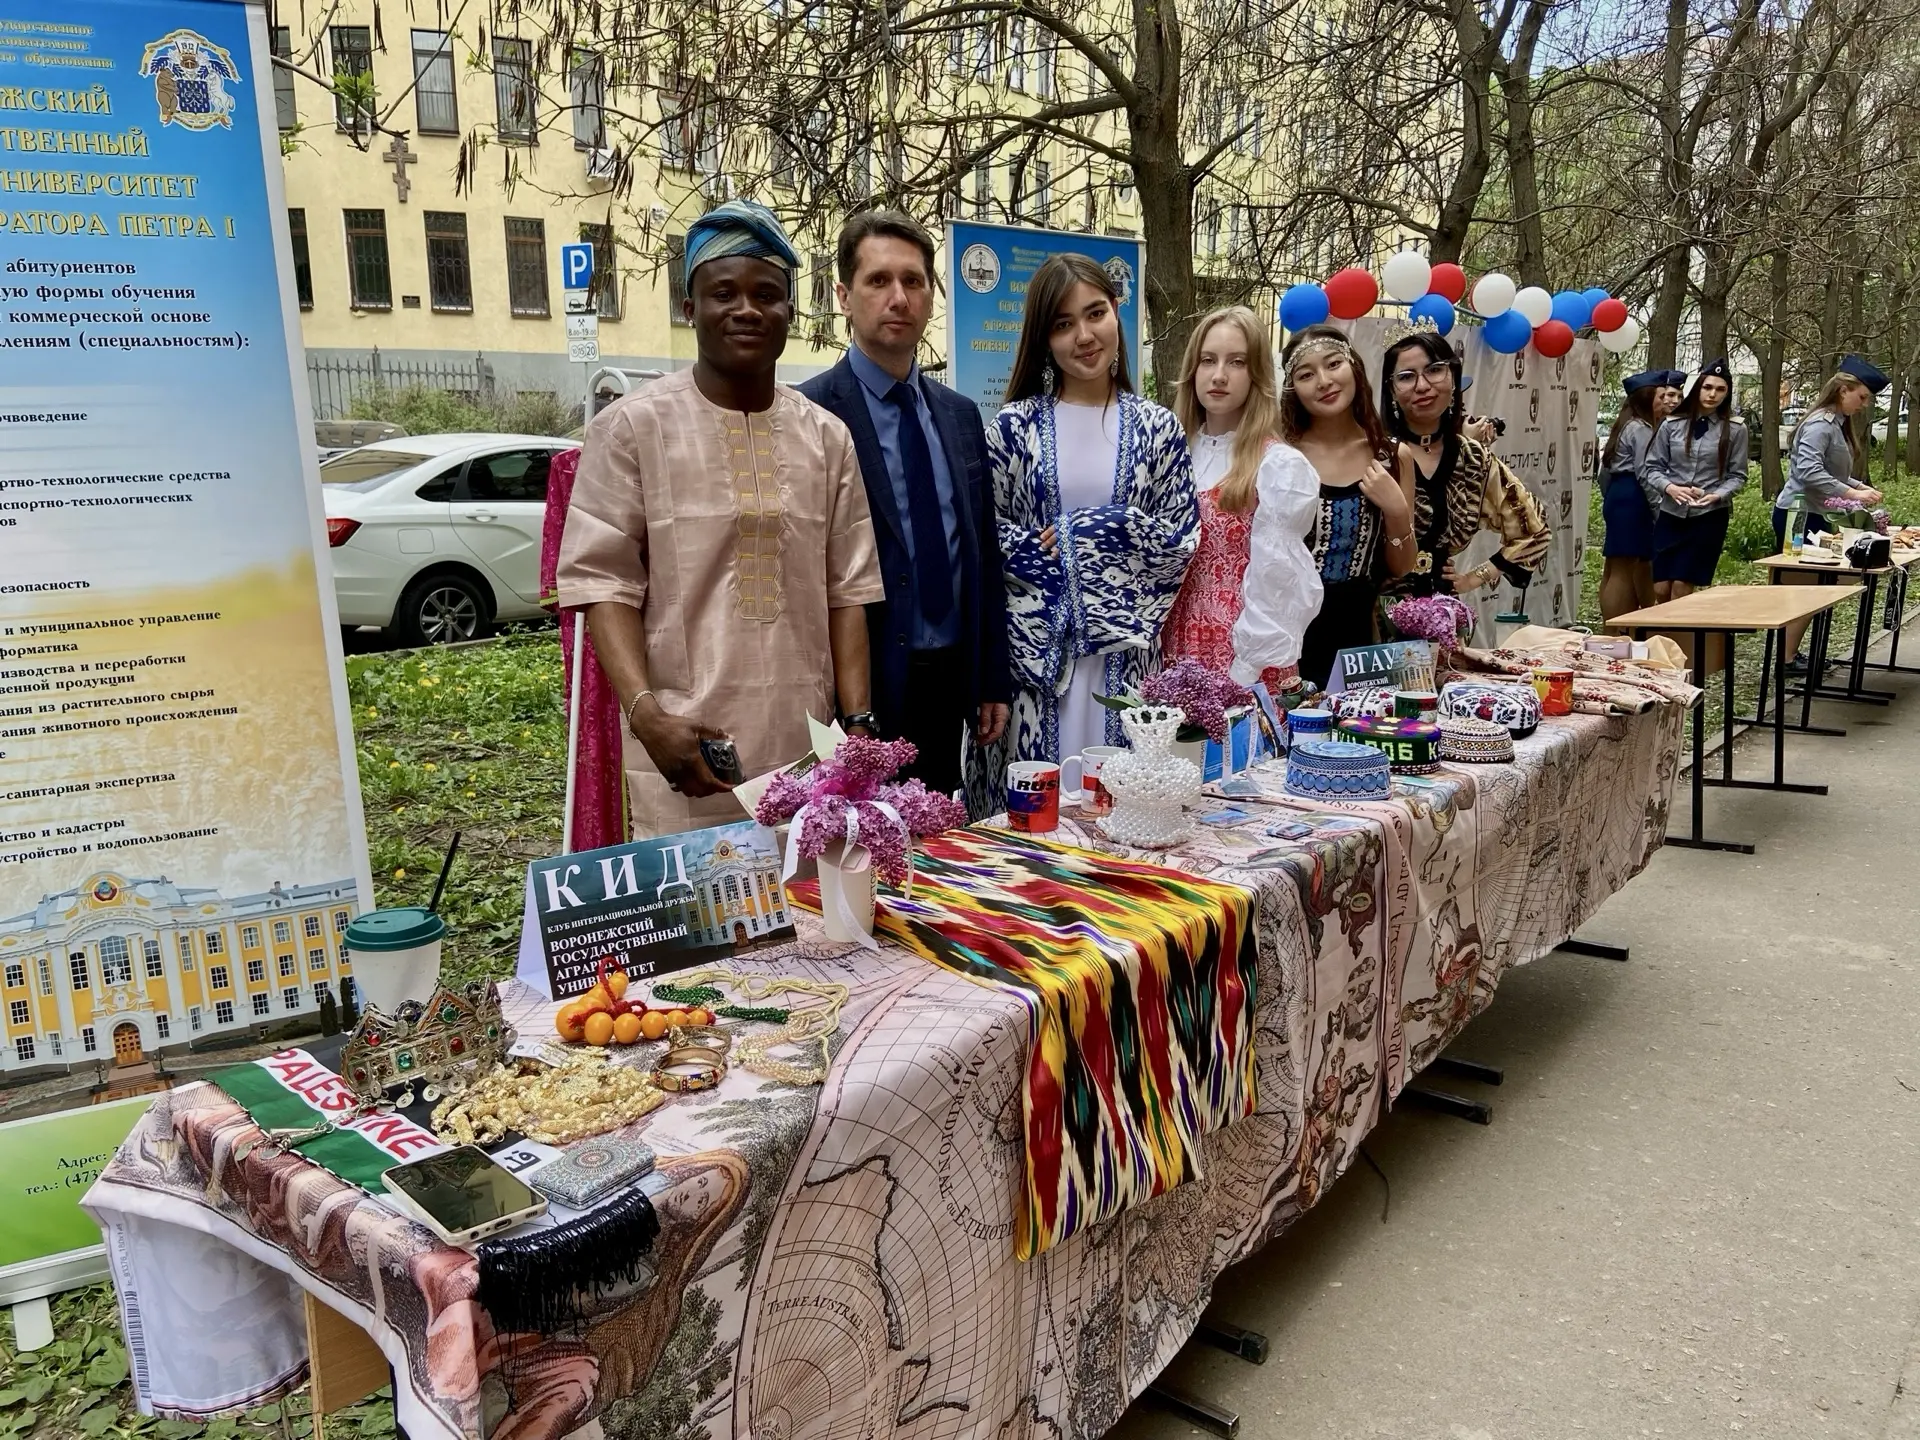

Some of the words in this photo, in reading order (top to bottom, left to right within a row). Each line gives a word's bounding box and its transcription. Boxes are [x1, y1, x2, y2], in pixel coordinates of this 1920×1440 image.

[119, 214, 216, 239] ПЕТРА
[6, 258, 136, 281] абитуриентов
[0, 288, 28, 303] ую
[36, 284, 104, 305] формы
[111, 284, 196, 304] обучения
[9, 309, 144, 329] коммерческой
[151, 312, 211, 325] основе
[79, 331, 250, 352] (специальностям):
[169, 469, 231, 484] средства
[5, 627, 14, 636] и
[20, 619, 134, 637] муниципальное
[140, 611, 221, 630] управление
[1, 664, 75, 680] изводства
[81, 664, 89, 673] и
[95, 654, 186, 674] переработки
[1342, 648, 1396, 676] ВГАУ
[56, 674, 136, 693] продукции
[39, 702, 55, 713] из
[62, 693, 165, 714] растительного
[171, 686, 215, 702] сырья
[42, 719, 121, 737] животного
[126, 706, 238, 728] происхождения
[95, 773, 176, 792] экспертиза
[1016, 780, 1060, 792] RUS
[42, 829, 51, 838] и
[56, 817, 125, 838] кадастры
[83, 843, 92, 852] и
[97, 825, 219, 851] водопользование
[547, 922, 570, 934] КЛУБ
[571, 902, 663, 928] ИНТЕРНАЦИОНАЛЬНОЙ
[664, 894, 698, 914] ДРУЖБЫ
[550, 917, 655, 953] ВОРОНЕЖСКИЙ
[552, 924, 689, 967] ГОСУДАРСТВЕННЫЙ
[270, 1049, 441, 1159] PALESINE
[57, 1153, 107, 1170] Адрес:
[767, 1295, 809, 1317] TERRE
